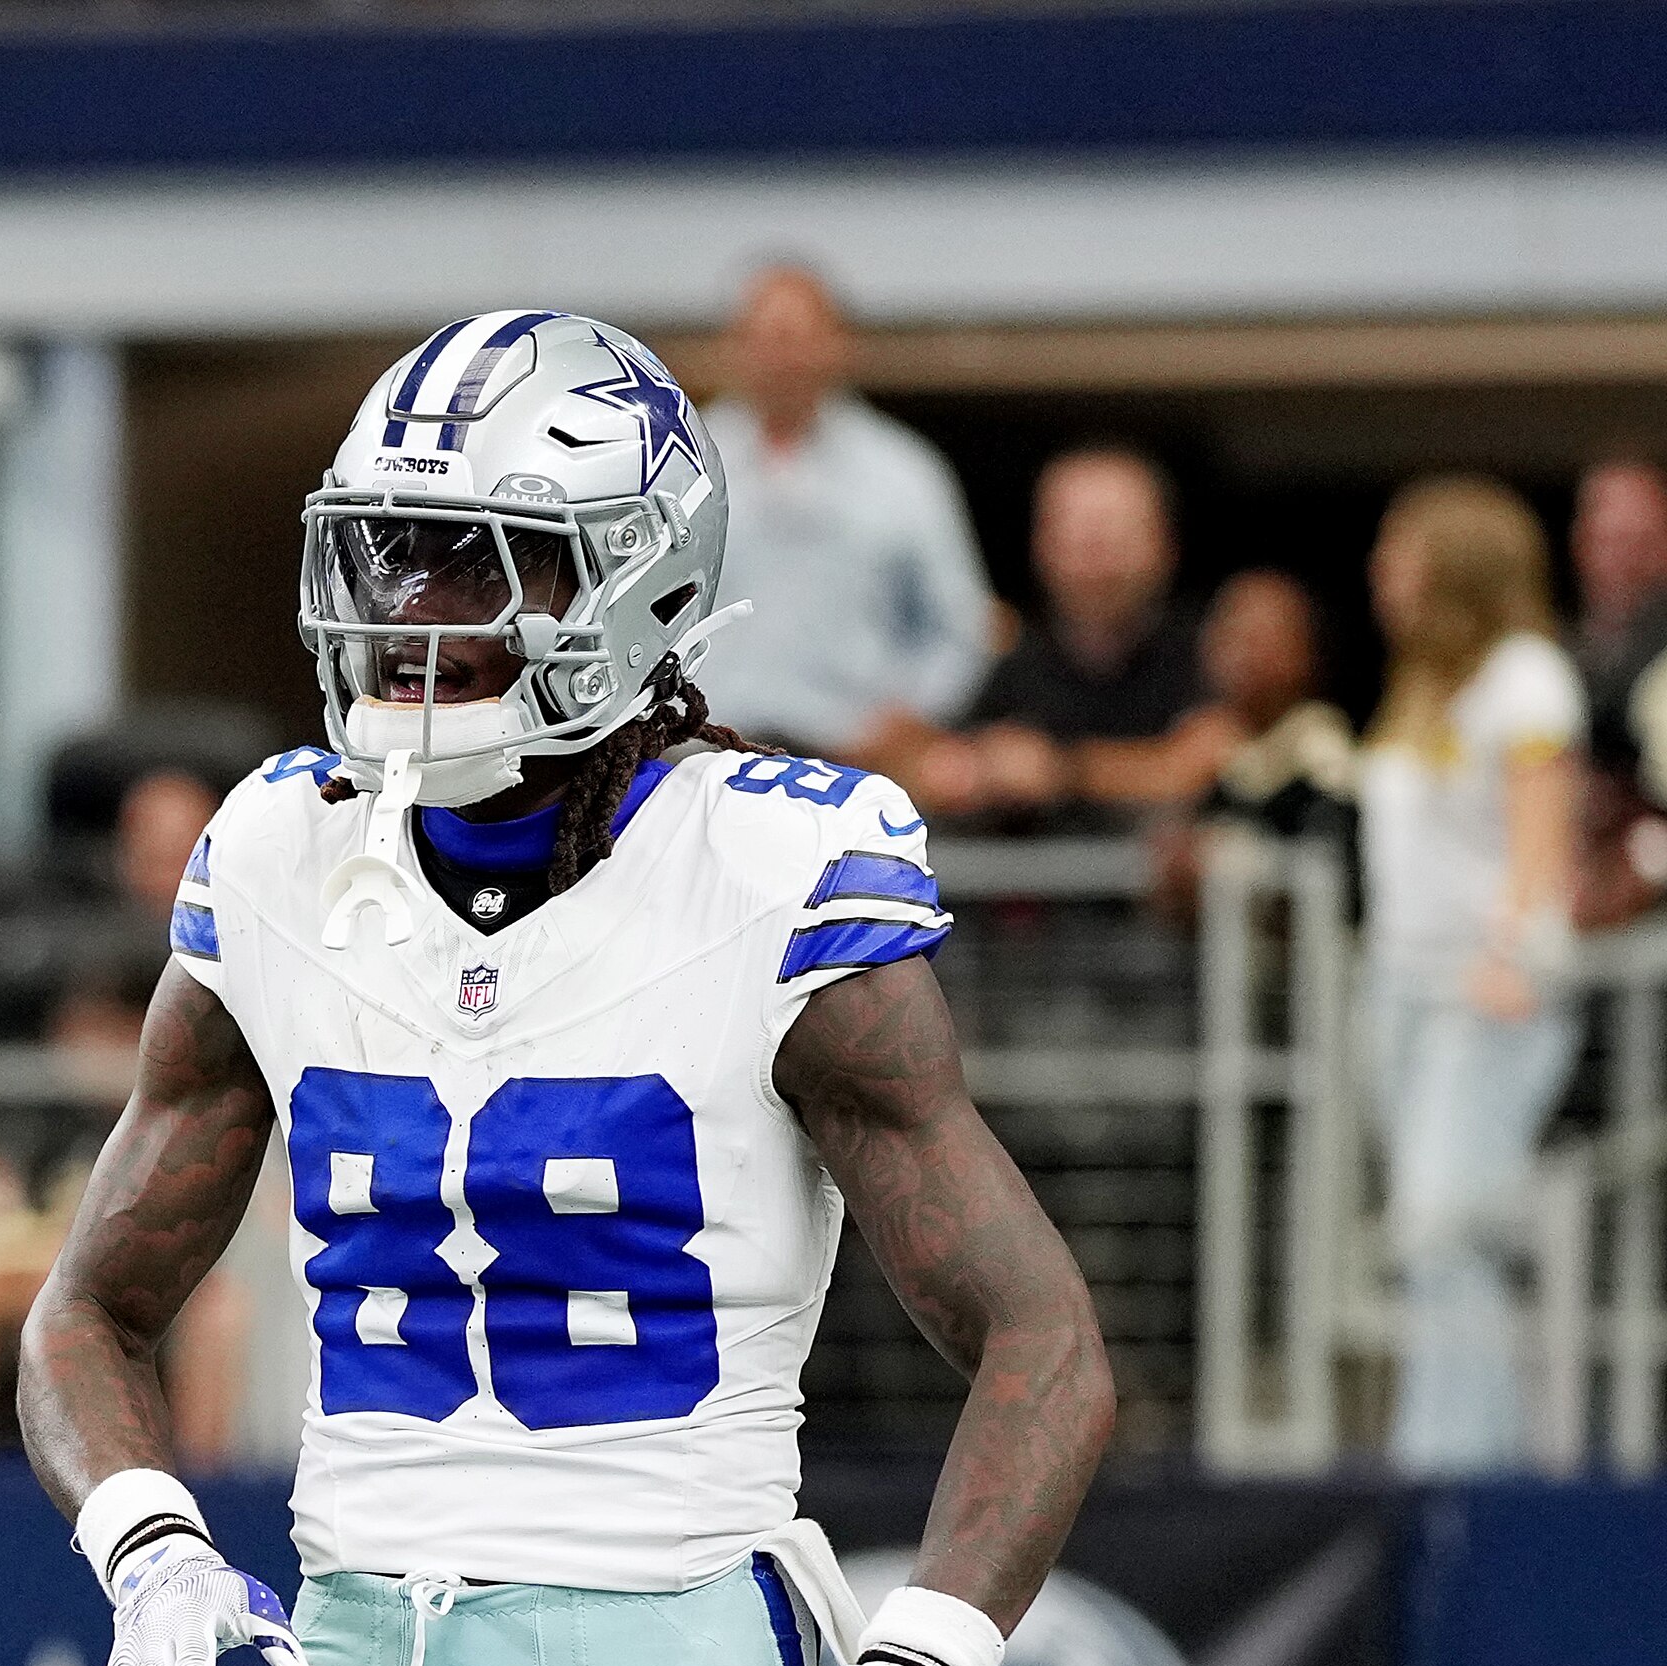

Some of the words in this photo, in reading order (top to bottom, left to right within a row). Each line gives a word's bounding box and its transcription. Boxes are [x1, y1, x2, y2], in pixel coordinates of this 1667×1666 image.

[374, 456, 449, 475] COWBOYS
[462, 985, 492, 1007] NFL
[289, 1066, 720, 1431] 88
